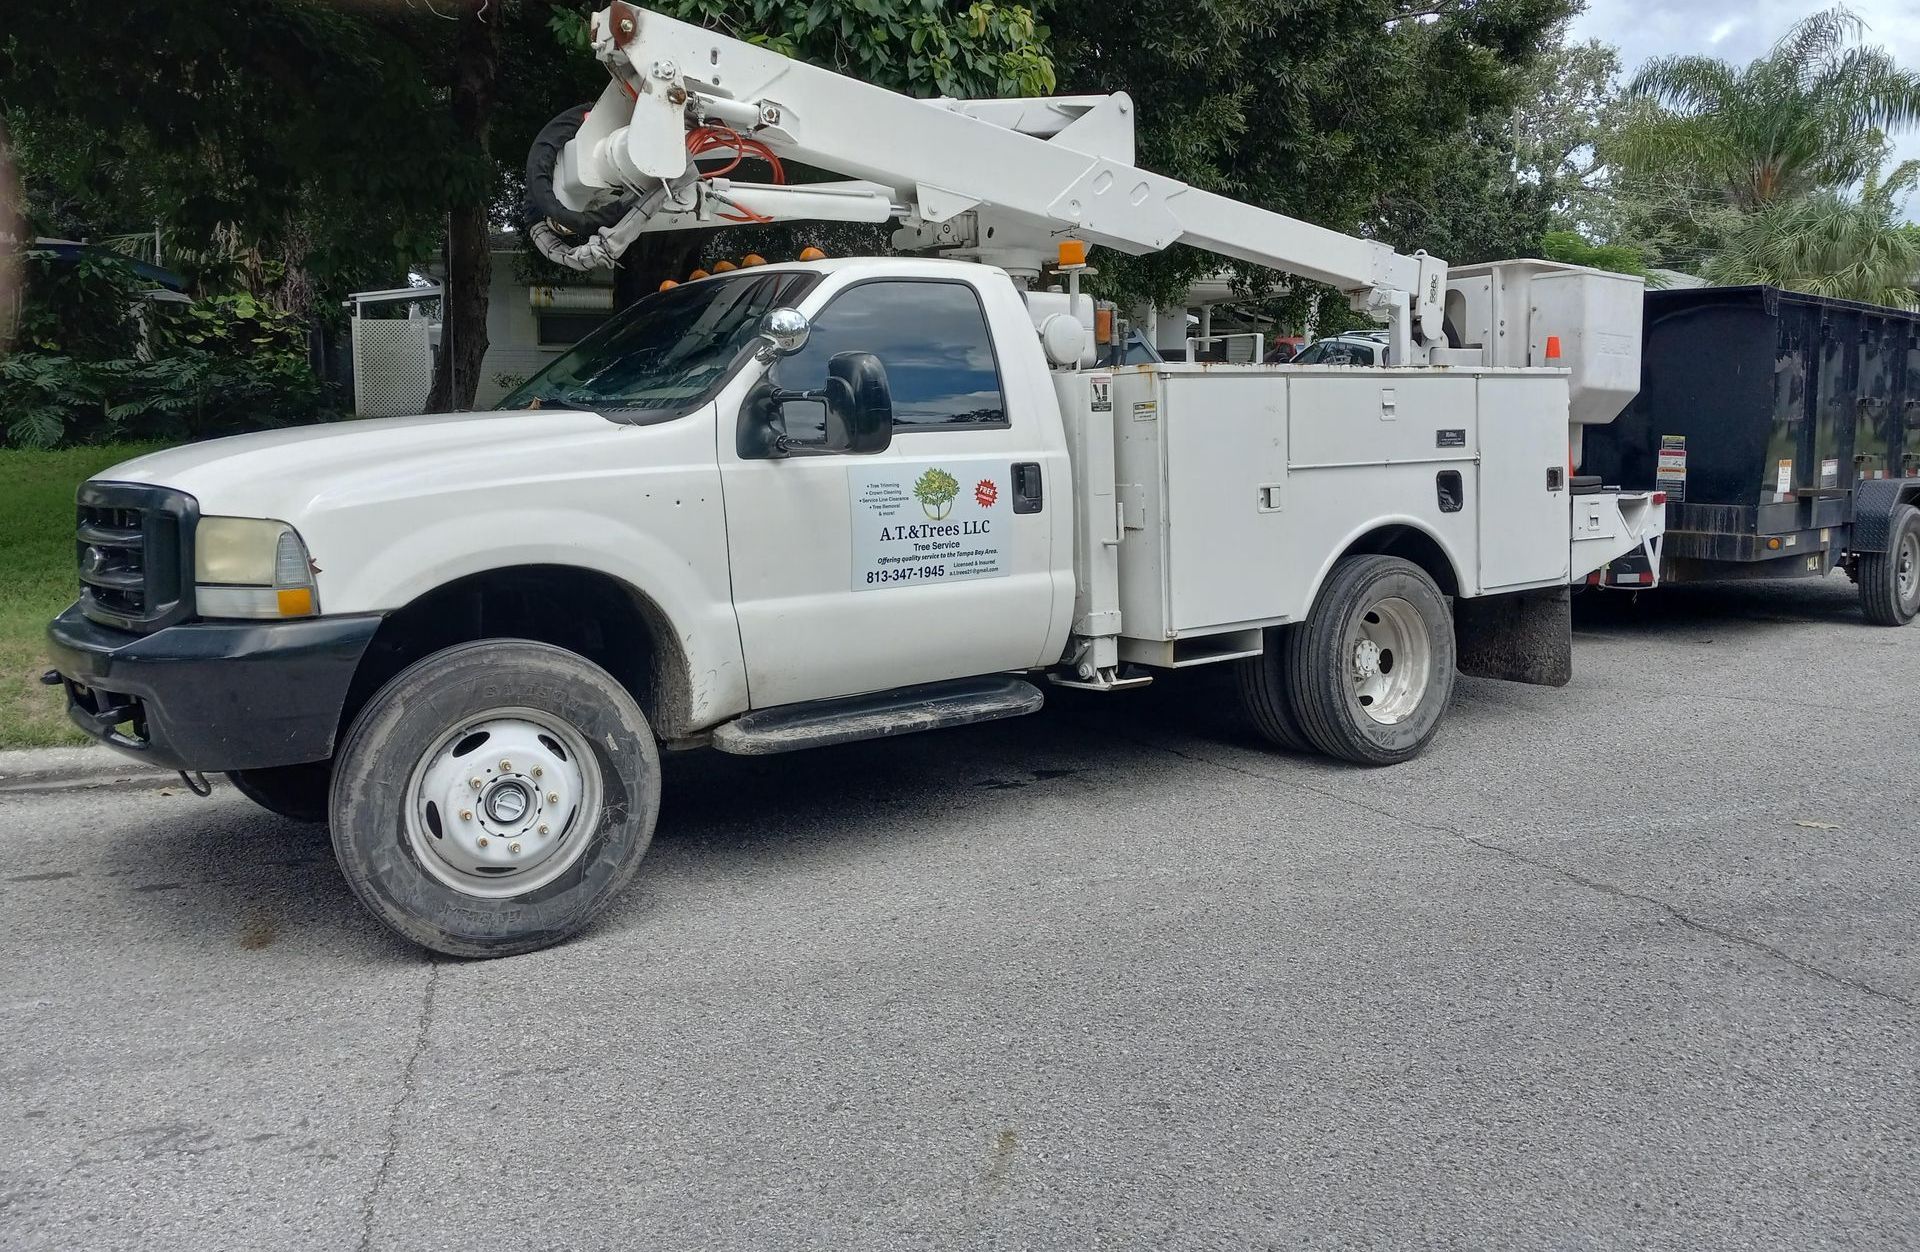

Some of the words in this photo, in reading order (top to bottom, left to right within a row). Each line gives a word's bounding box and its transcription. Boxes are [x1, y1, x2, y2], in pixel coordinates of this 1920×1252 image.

[979, 486, 994, 495] FREE
[880, 524, 960, 541] A.T.&Trees
[963, 520, 990, 535] LLC
[914, 543, 931, 552] Tree
[932, 541, 960, 550] Service
[878, 556, 901, 565] Offering
[901, 555, 921, 563] quality
[957, 550, 974, 558] Tampa
[953, 560, 973, 568] Licensed
[867, 565, 945, 583] 813-347-1945
